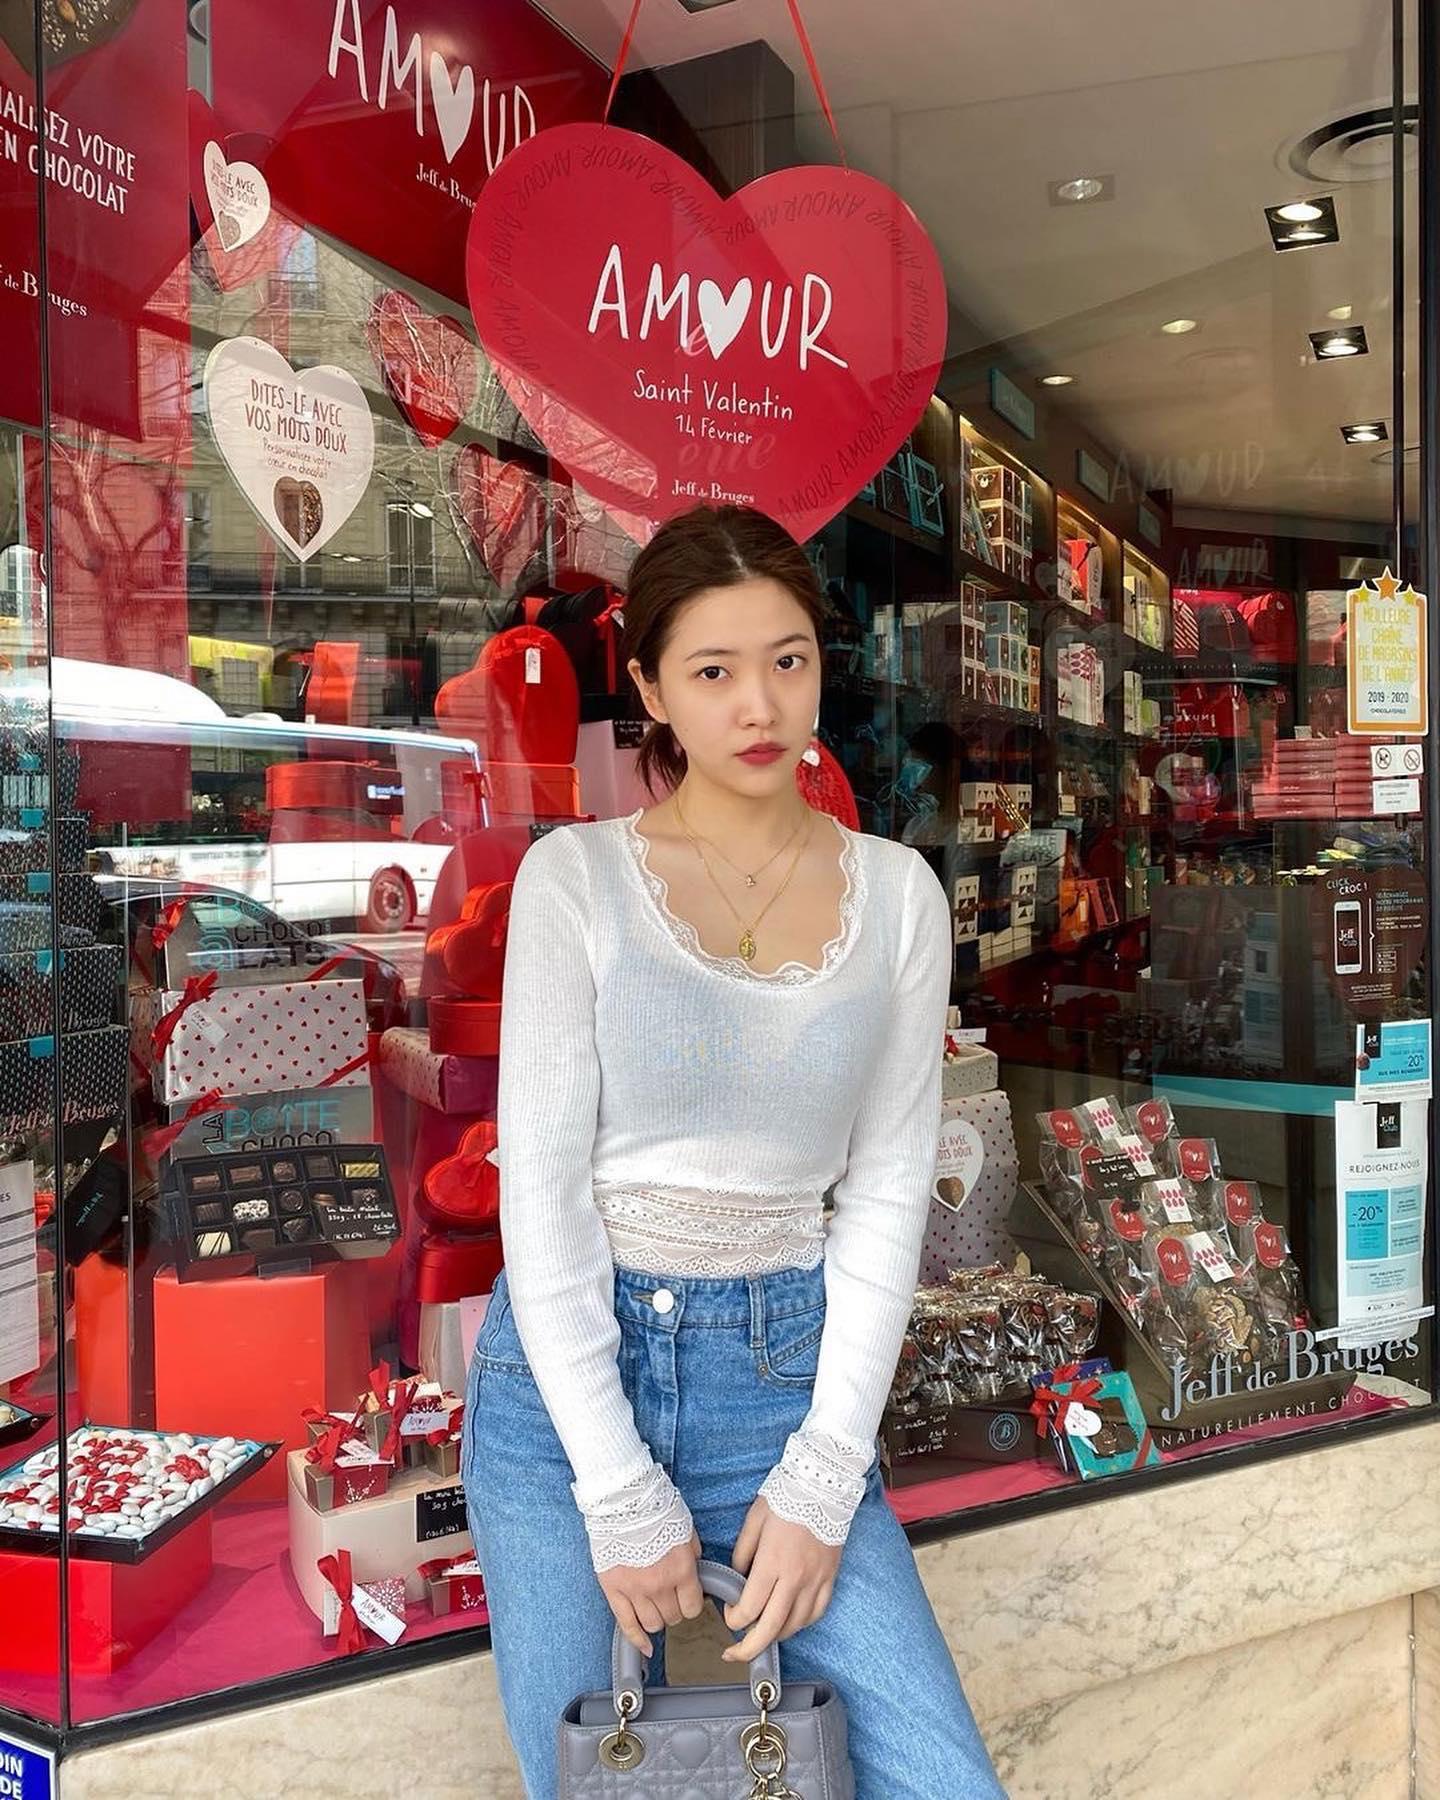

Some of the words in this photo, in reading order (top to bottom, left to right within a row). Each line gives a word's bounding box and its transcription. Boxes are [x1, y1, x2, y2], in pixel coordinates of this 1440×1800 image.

[77, 127, 136, 182] VOTRE
[28, 144, 128, 214] CHOCOLAT
[416, 162, 439, 188] Jeff
[4, 273, 19, 290] de
[21, 269, 88, 317] Buges
[251, 378, 306, 415] DITES-LE
[312, 397, 343, 428] AVEC
[633, 369, 693, 405] Saint
[703, 380, 793, 421] Valentin
[245, 403, 271, 433] VOS
[277, 414, 310, 443] MOTS
[315, 426, 347, 455] DOUX
[675, 414, 695, 437] 14
[701, 416, 752, 444] Février
[671, 480, 696, 496] Jeff
[711, 482, 755, 505] Bruges
[1368, 691, 1385, 703] 2019
[1391, 691, 1409, 704] 2020
[1326, 877, 1349, 890] CLICK
[1339, 883, 1362, 895] CROC
[234, 920, 323, 943] CHOCO
[1338, 928, 1354, 942] Jeff
[1161, 1351, 1243, 1421] Jeff
[1246, 1361, 1277, 1392] de
[1285, 1327, 1420, 1384] Bruges
[1161, 1400, 1317, 1448] NATURELLEMENT
